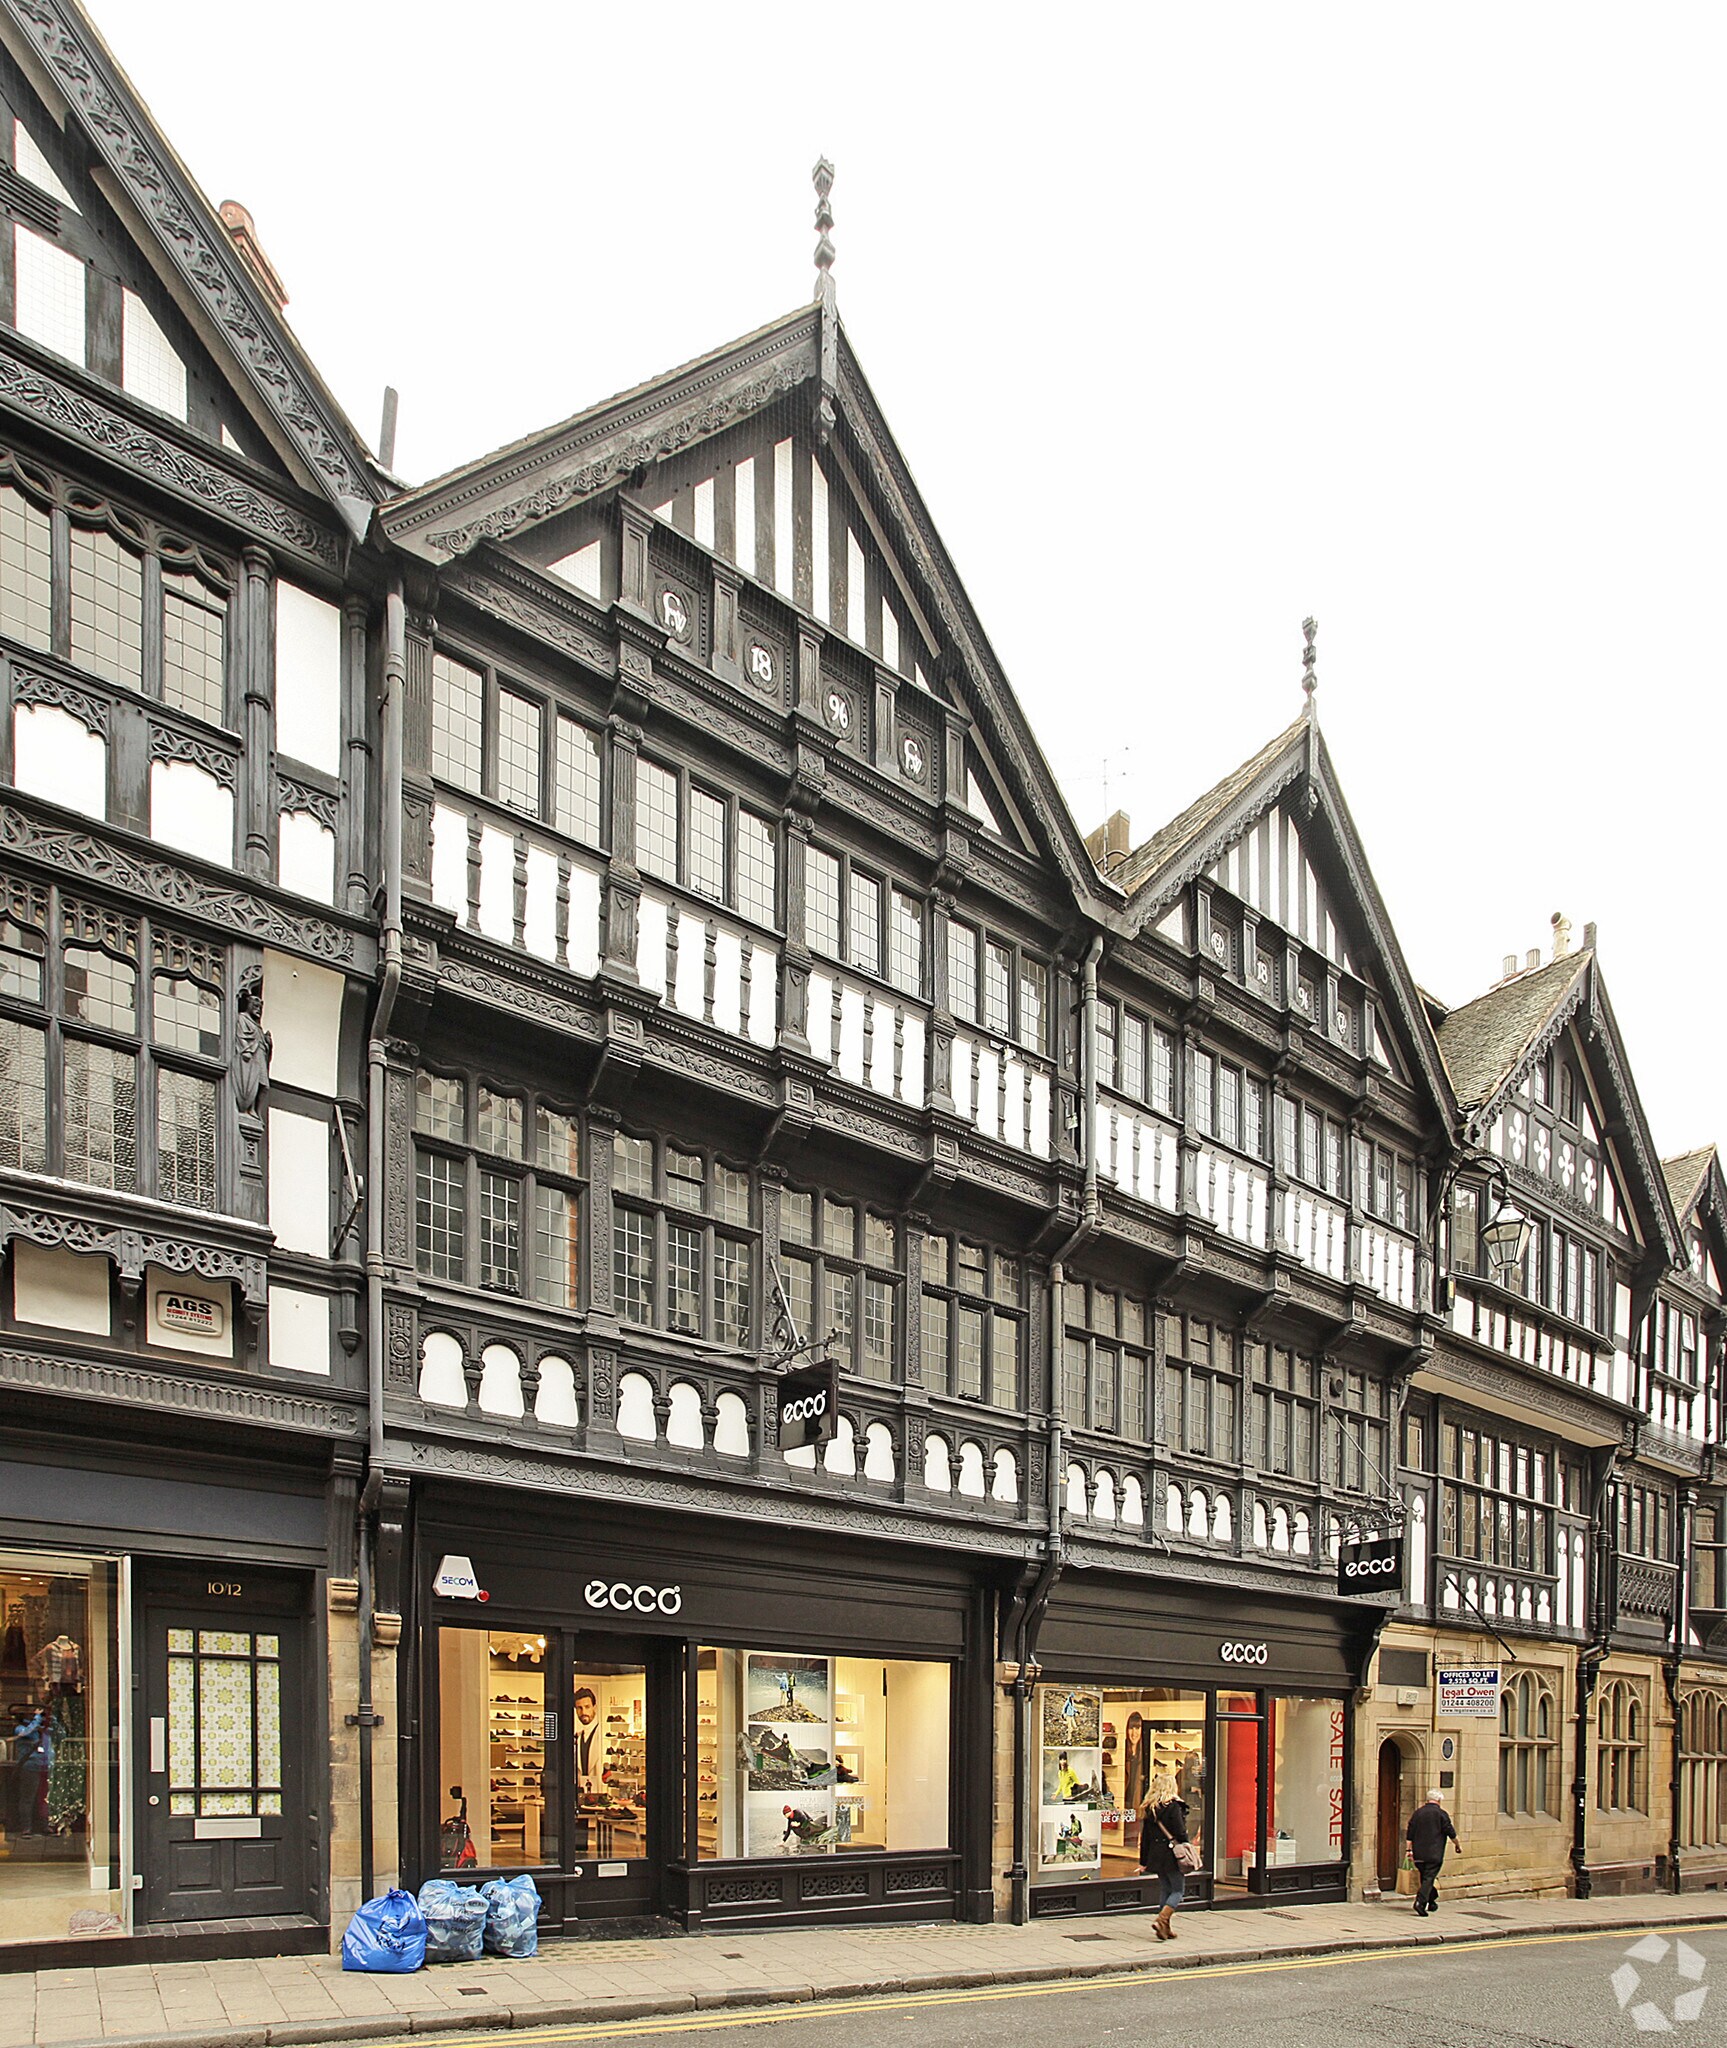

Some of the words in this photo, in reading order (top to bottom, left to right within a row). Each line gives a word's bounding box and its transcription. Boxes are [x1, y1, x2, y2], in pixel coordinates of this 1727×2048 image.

[751, 645, 773, 682] 18
[829, 694, 849, 729] 96
[1257, 961, 1268, 984] 18
[166, 1297, 212, 1314] AGS
[166, 1308, 189, 1316] SECURITY
[190, 1312, 213, 1321] SYSTEMS
[783, 1390, 827, 1424] ecco
[1345, 1555, 1396, 1577] ecco
[441, 1576, 474, 1587] SECOM
[584, 1580, 682, 1615] ecco
[1221, 1641, 1268, 1665] ecco
[1442, 1687, 1464, 1699] Legat
[1467, 1687, 1495, 1696] Owen
[1330, 1711, 1345, 1768] SALE
[1329, 1788, 1344, 1847] SALE
